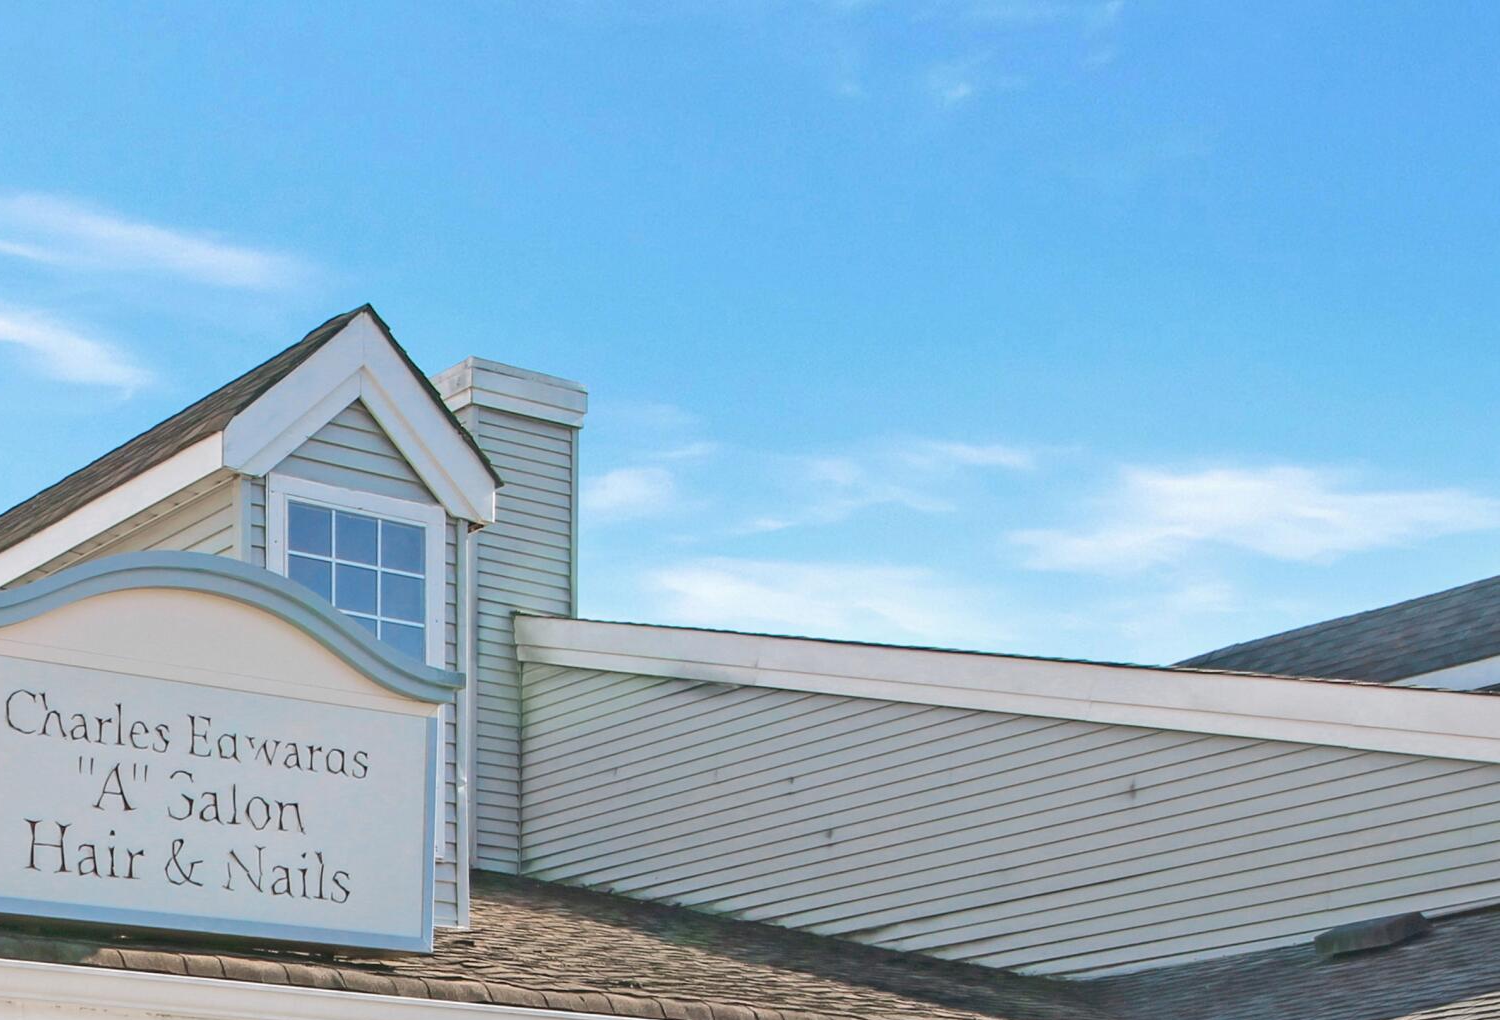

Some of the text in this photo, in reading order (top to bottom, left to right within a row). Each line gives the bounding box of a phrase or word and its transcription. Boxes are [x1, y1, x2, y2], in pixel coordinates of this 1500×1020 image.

[5, 689, 170, 753] Charles
[78, 755, 306, 835] "A" Salon
[24, 818, 351, 904] Hair & Nails
